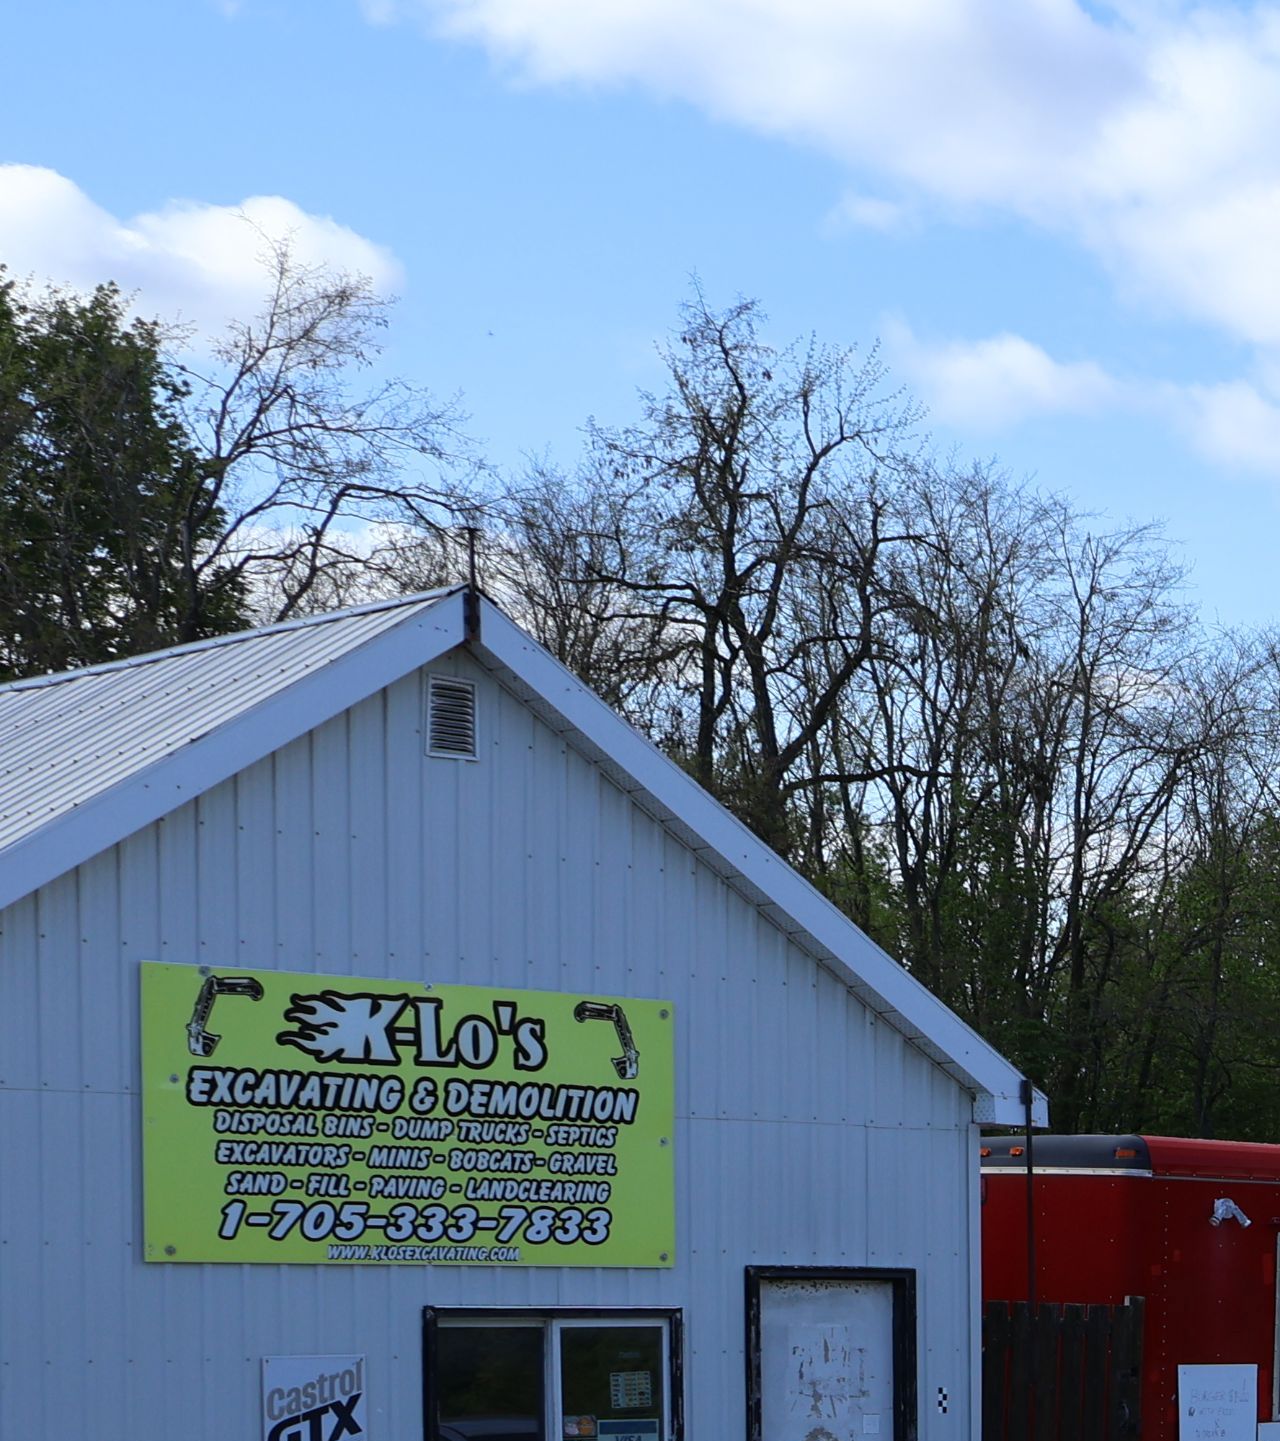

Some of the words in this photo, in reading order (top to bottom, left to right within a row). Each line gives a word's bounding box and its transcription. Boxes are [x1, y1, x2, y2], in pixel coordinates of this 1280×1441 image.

[187, 1066, 404, 1114] EXCAVATING
[409, 1076, 438, 1115] &
[444, 1078, 640, 1124] DEMOLITION
[213, 1110, 319, 1136] DISPOSAL
[322, 1113, 376, 1138] BINS
[392, 1116, 453, 1141] DUMP
[456, 1120, 531, 1145] TRUCKS
[545, 1124, 618, 1147] SEPTICS
[216, 1140, 351, 1168] EXCAVATORS
[367, 1146, 432, 1170] MINIS
[448, 1148, 535, 1173] BOBCATS
[548, 1152, 618, 1176] GRAVEL
[225, 1171, 288, 1195] SAND
[306, 1173, 351, 1197] FILL
[369, 1175, 446, 1199] PAVING
[465, 1177, 611, 1204] LANDCLEARING
[218, 1200, 612, 1244] 1-705-333-7833
[327, 1244, 520, 1261] WWW.KLOSEXCAVATING.COM
[266, 1358, 363, 1421] Castrol
